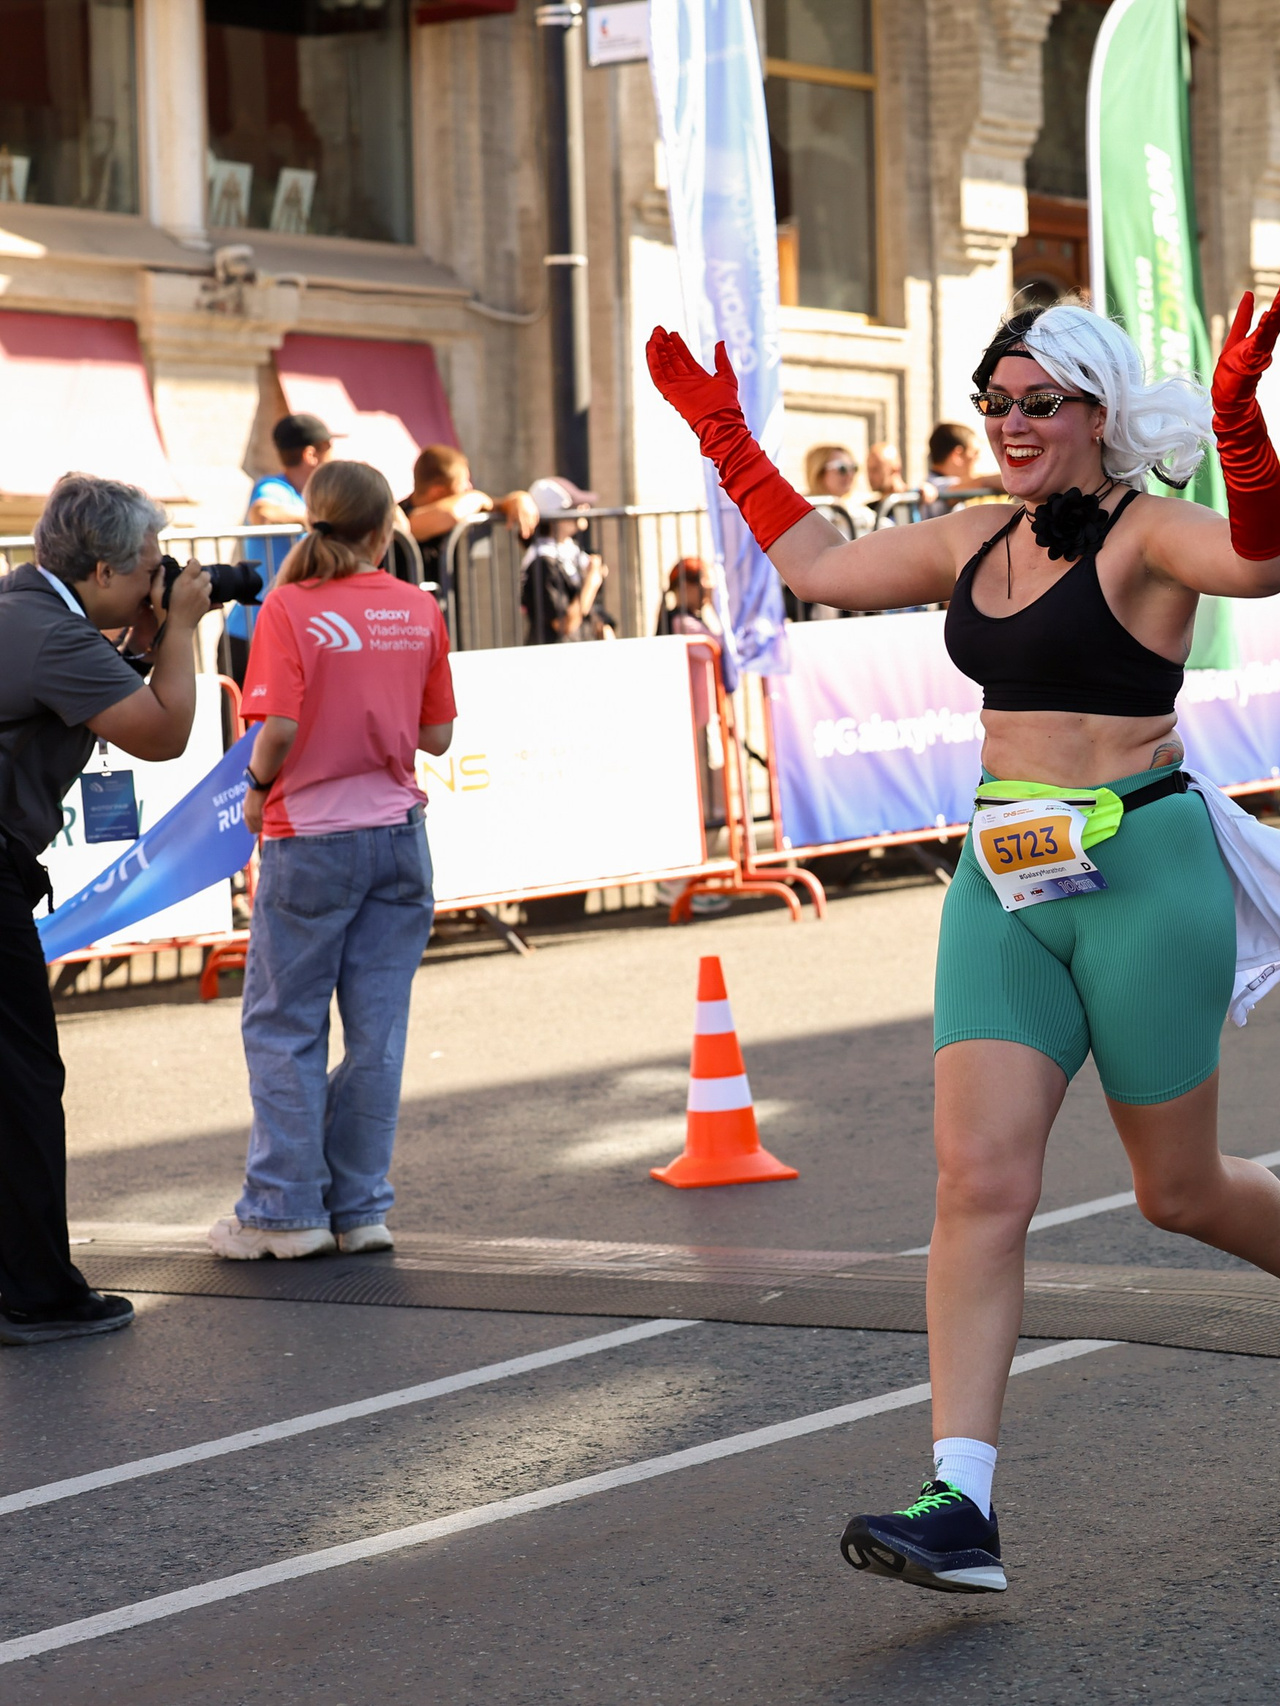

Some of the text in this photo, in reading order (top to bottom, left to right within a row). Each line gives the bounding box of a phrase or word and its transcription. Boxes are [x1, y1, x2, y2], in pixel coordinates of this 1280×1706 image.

[364, 608, 410, 623] Galaxy
[369, 638, 425, 651] Marathon
[416, 753, 491, 793] NS
[212, 781, 250, 807] БЕГОВО
[217, 799, 245, 833] RU
[993, 825, 1058, 864] 5723
[1019, 866, 1067, 880] #GalaxyMarathon
[1080, 862, 1092, 871] D
